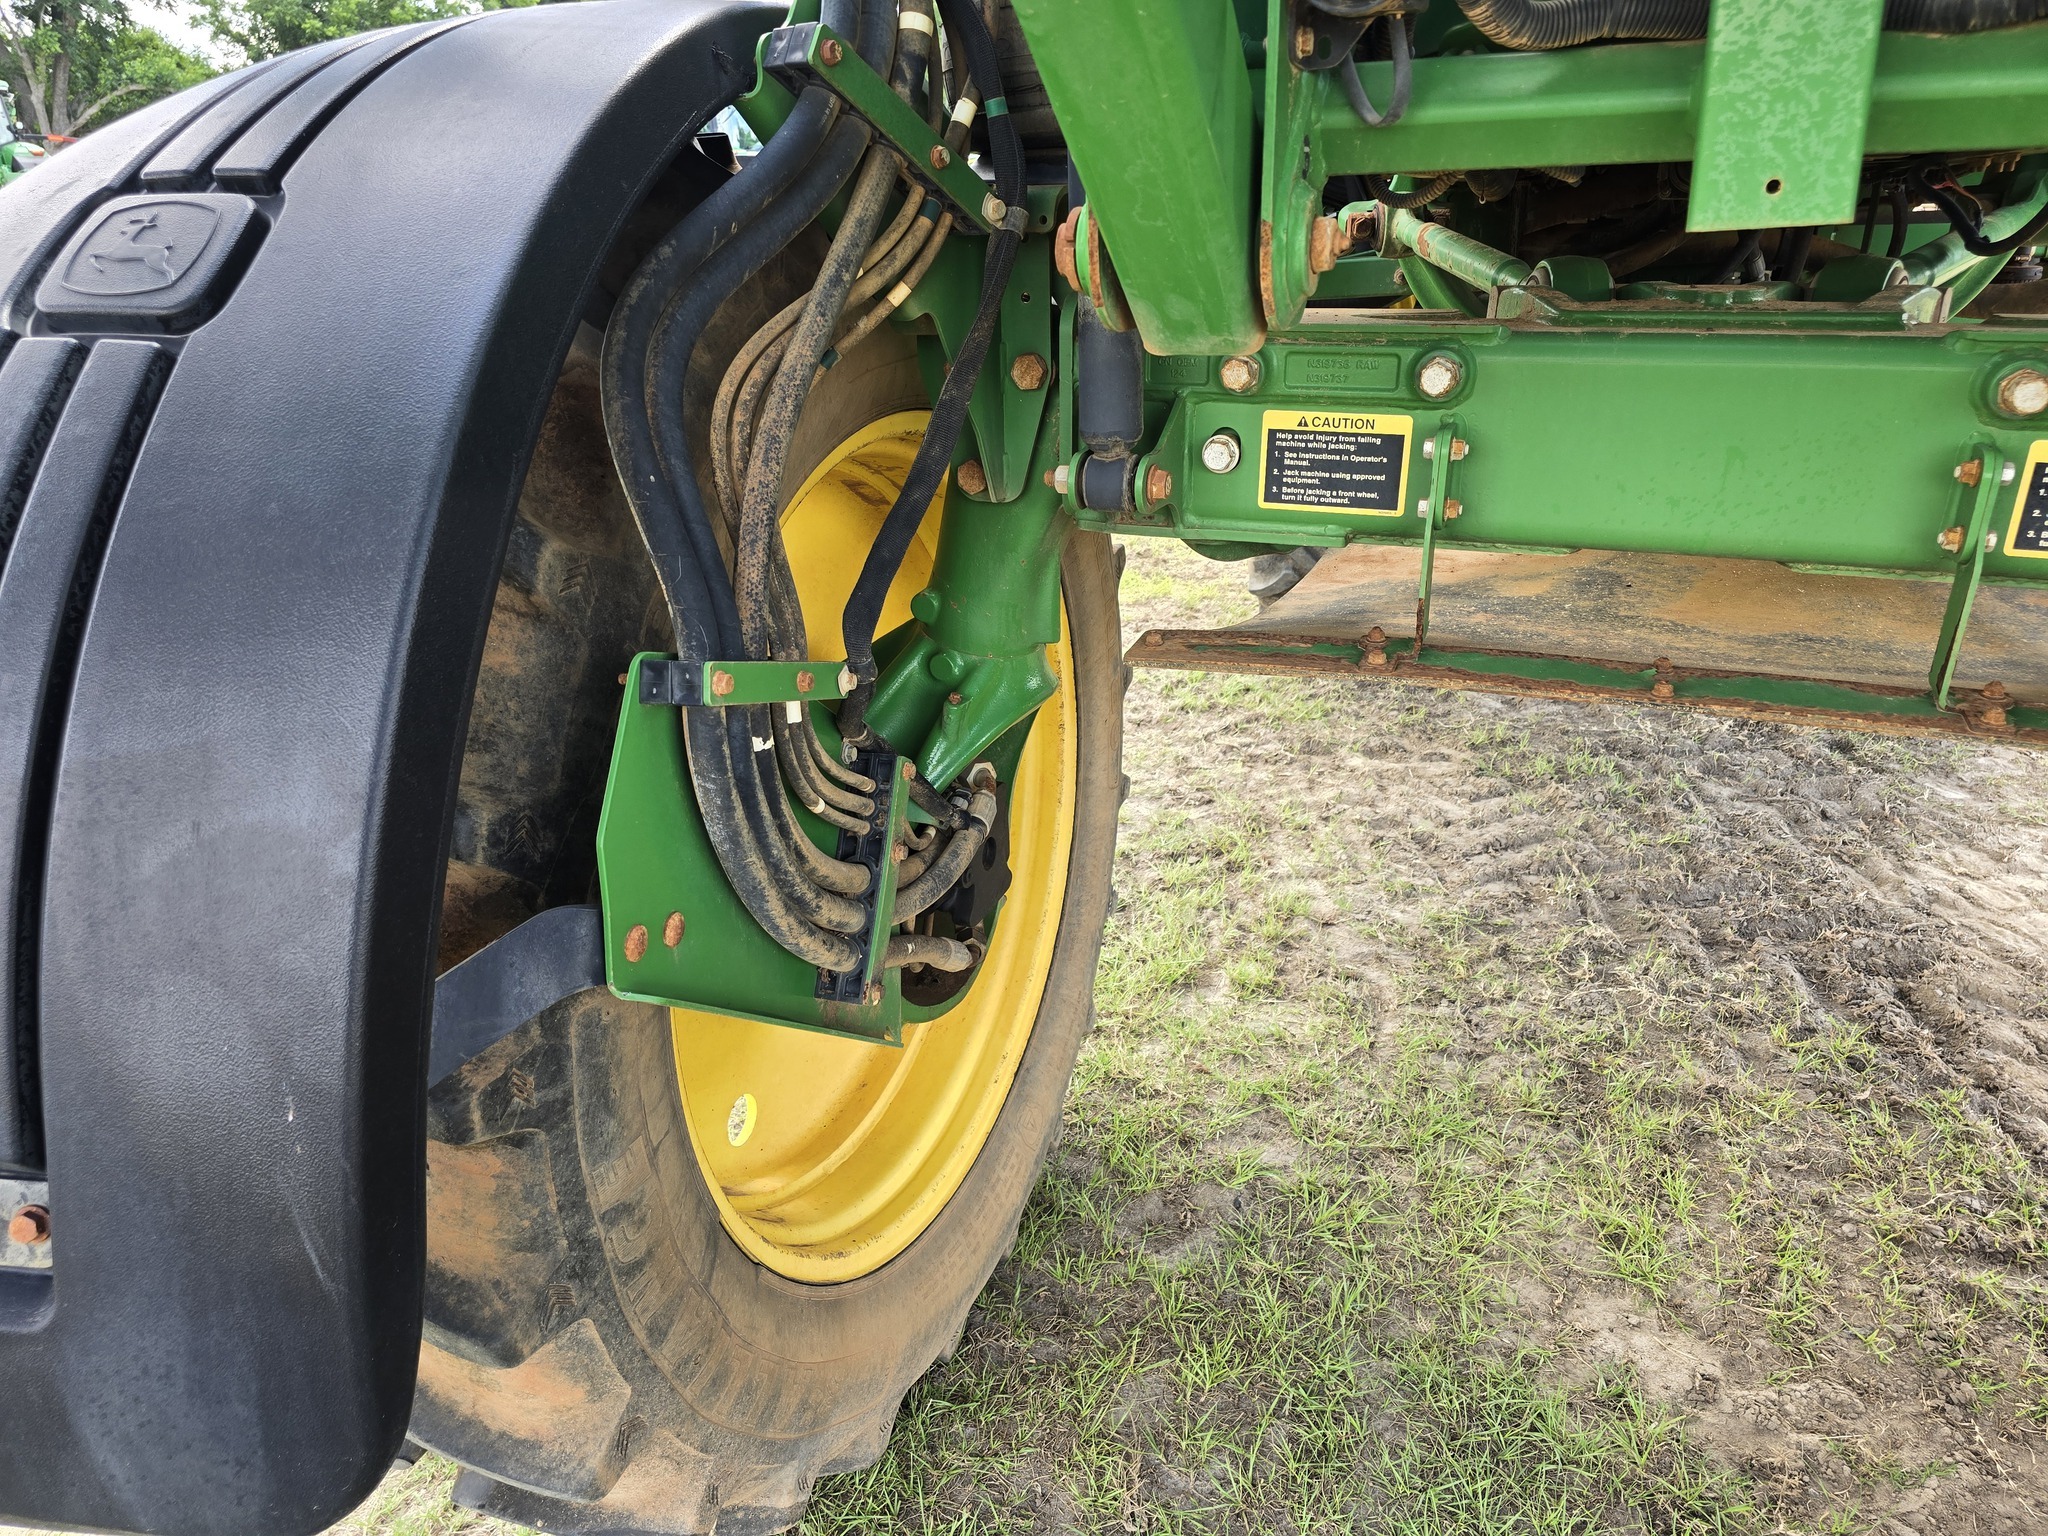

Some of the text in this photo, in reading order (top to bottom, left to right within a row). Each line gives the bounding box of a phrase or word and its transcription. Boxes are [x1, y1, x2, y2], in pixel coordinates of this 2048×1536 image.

[1356, 359, 1380, 370] RAW
[1312, 416, 1375, 430] CAUTION
[1276, 432, 1292, 440] Help
[1316, 434, 1337, 443] injury
[1358, 436, 1382, 445] falling
[1275, 440, 1306, 448] machine
[1328, 443, 1358, 451] jacking:
[1284, 458, 1311, 466] Manual.
[1299, 451, 1340, 461] instructions
[1350, 455, 1388, 463] Operator's
[1300, 470, 1330, 478] machine
[1331, 472, 1351, 480] using
[1282, 486, 1305, 494] Before
[1305, 488, 1331, 497] jacking
[1356, 491, 1379, 499] wheel,
[1303, 495, 1319, 503] fully
